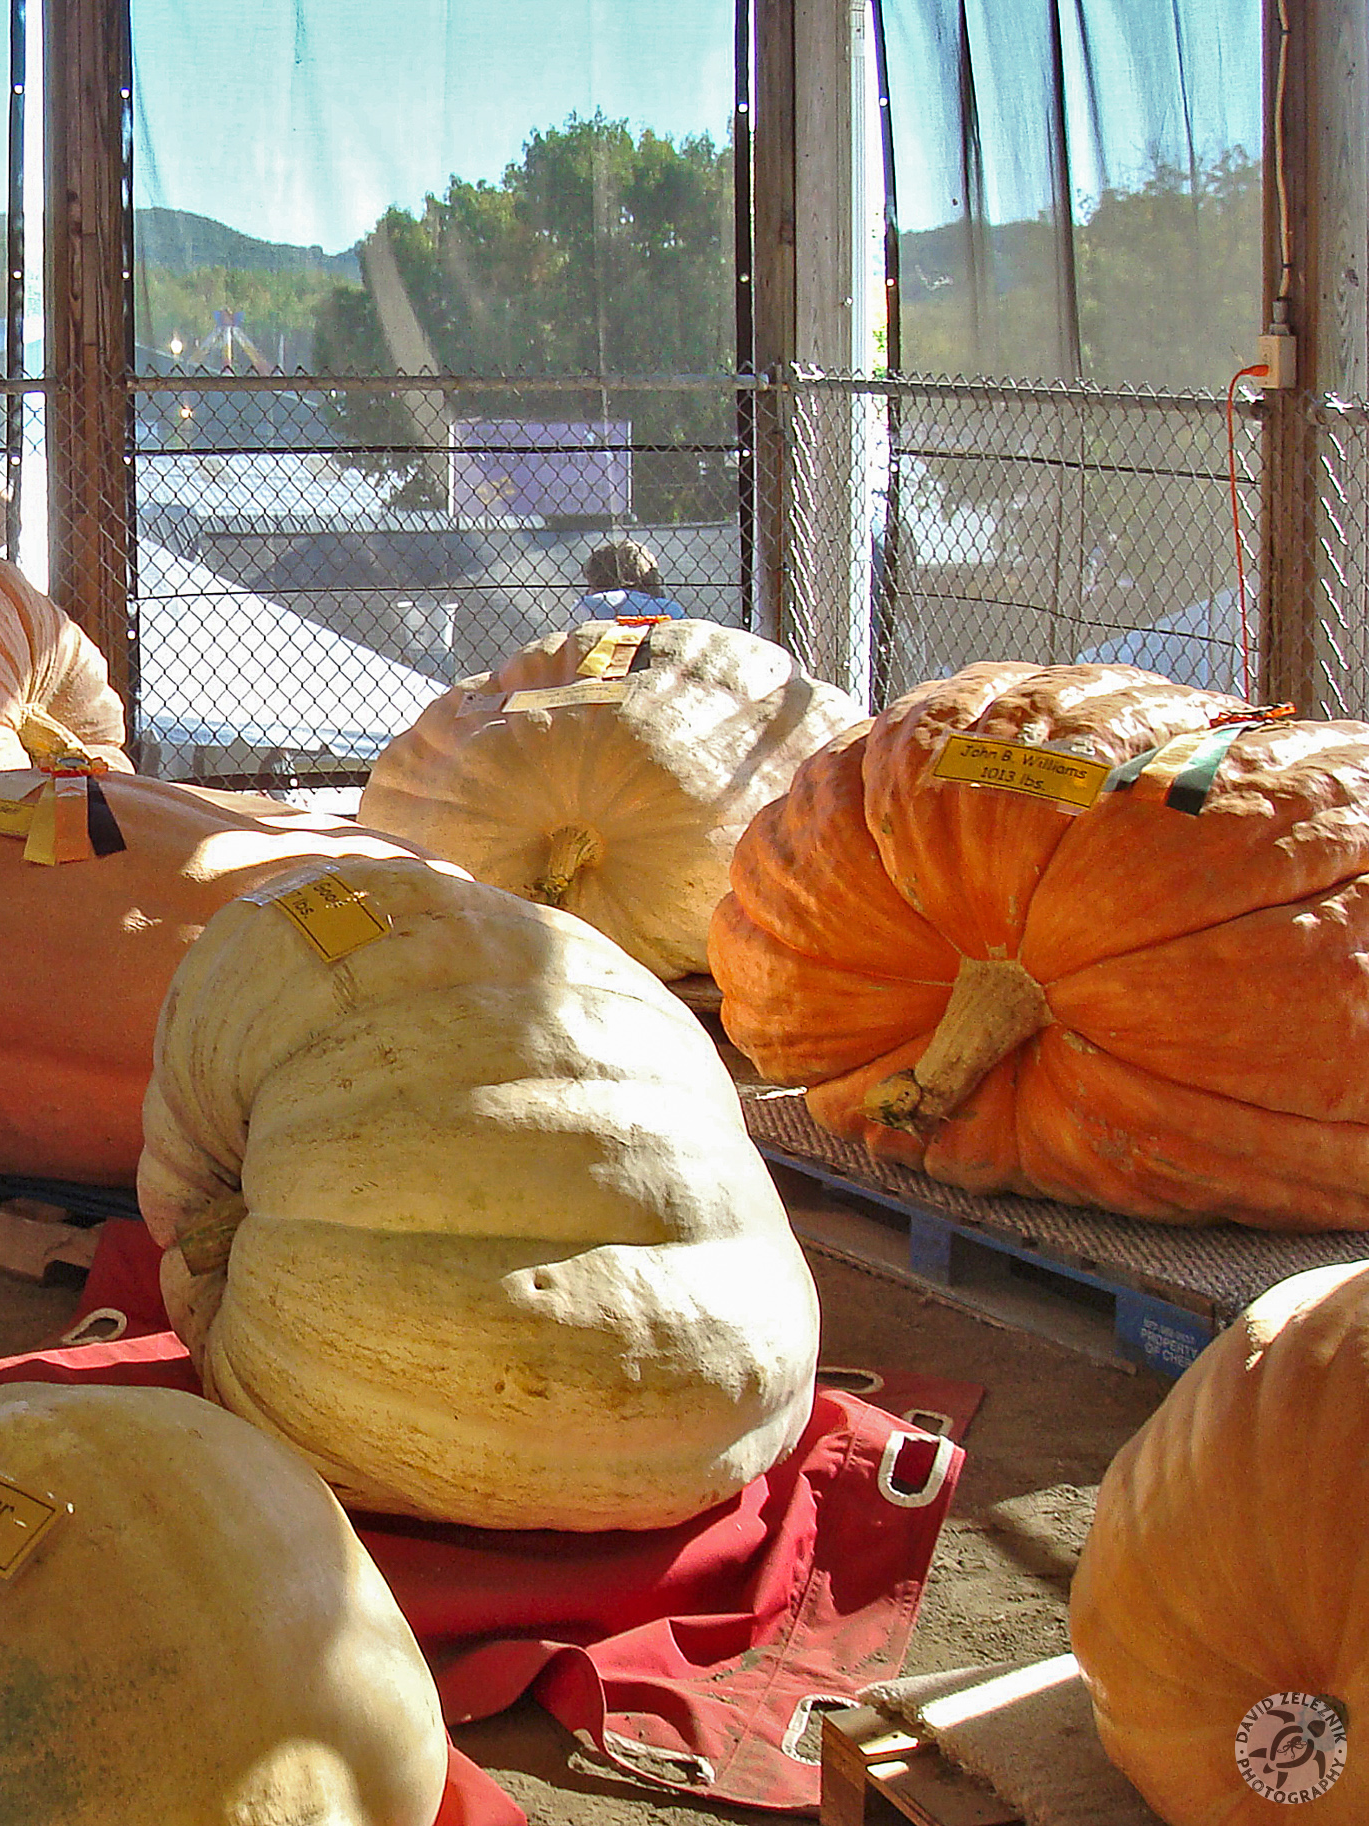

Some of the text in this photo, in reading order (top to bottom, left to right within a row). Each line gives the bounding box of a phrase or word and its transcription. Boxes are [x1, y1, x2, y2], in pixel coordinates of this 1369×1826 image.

[960, 744, 1088, 780] John B. Williams
[981, 766, 1047, 791] 1013 lbs.
[1140, 1327, 1198, 1359] PROPERTY
